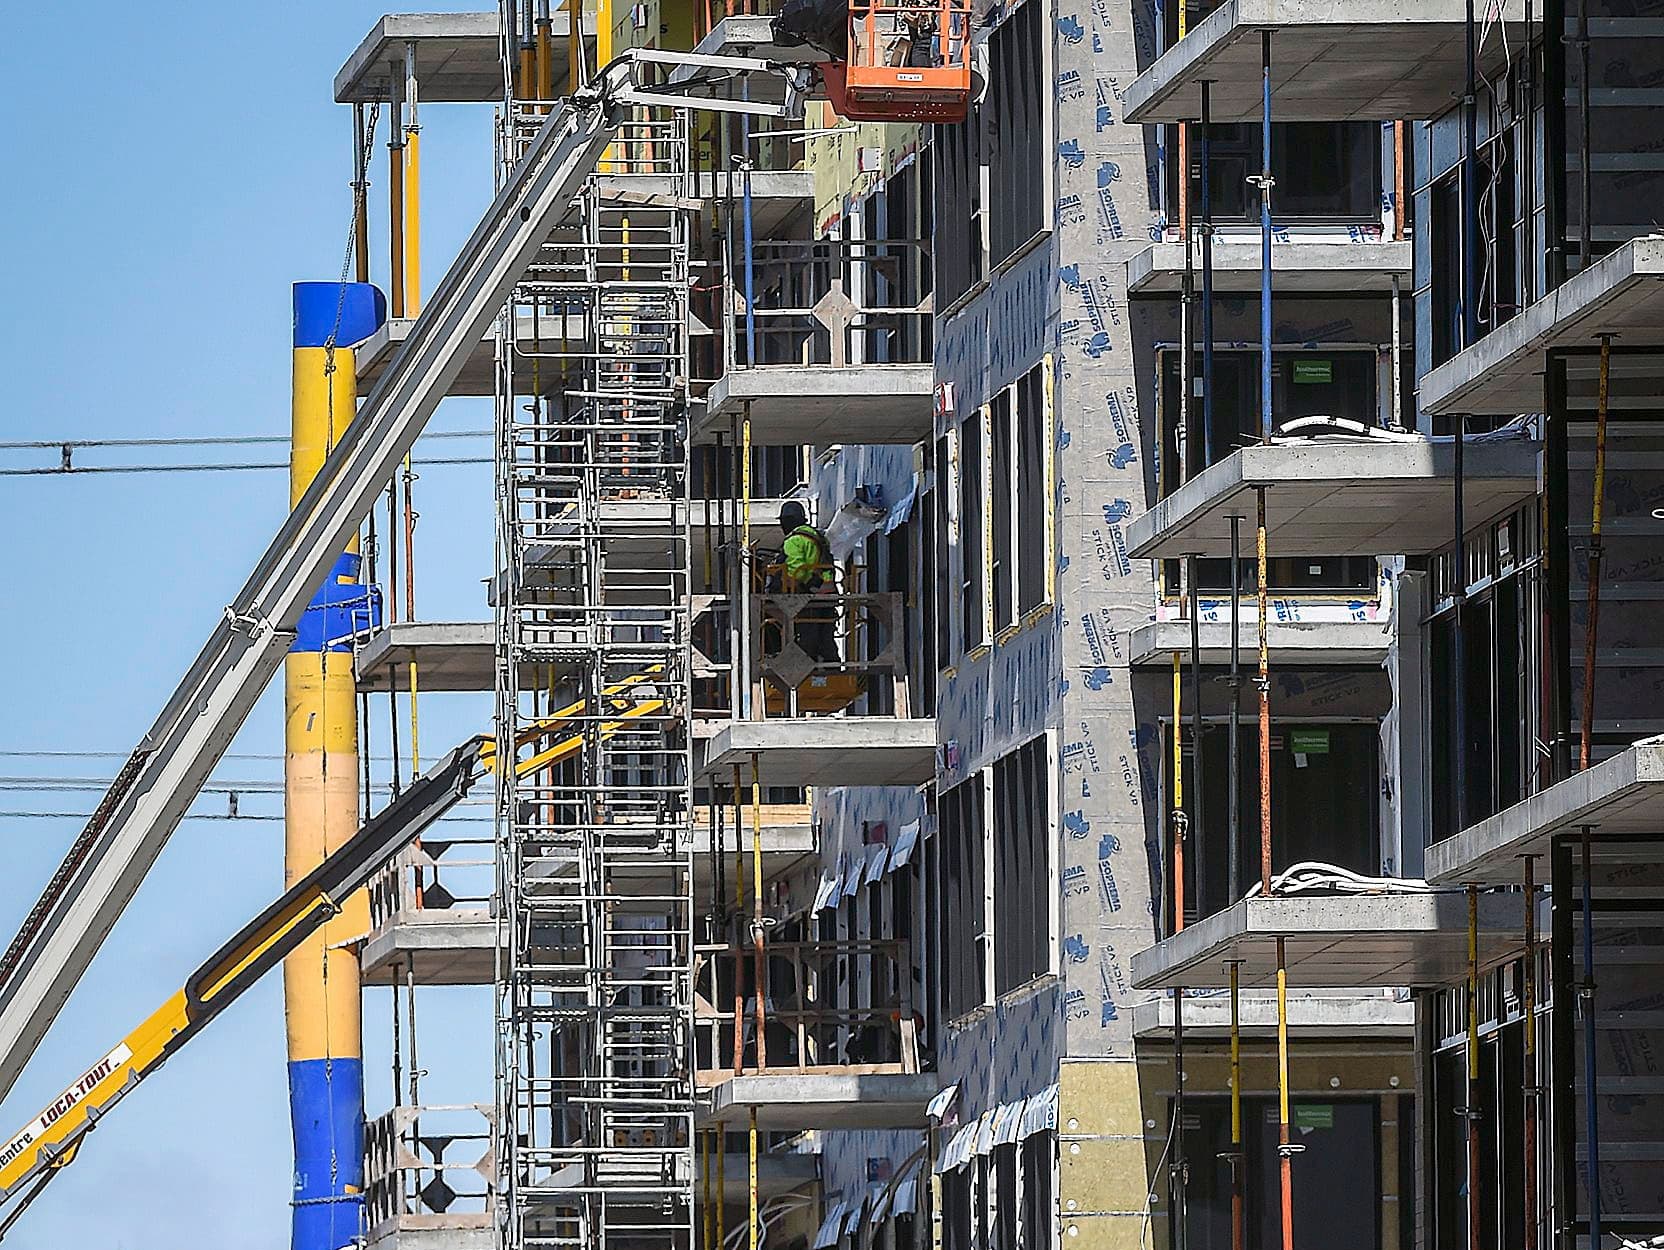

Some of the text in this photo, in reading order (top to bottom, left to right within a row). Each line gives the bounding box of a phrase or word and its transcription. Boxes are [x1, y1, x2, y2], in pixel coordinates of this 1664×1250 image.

[1101, 188, 1124, 239] SOPREMA
[1080, 282, 1101, 332] SOPREMA
[1100, 275, 1121, 326] STICK VP
[1105, 391, 1127, 443] SOPREMA
[1126, 386, 1135, 403] VP
[1092, 529, 1111, 581] STICK VP
[1112, 524, 1132, 576] SOPREMA
[1081, 613, 1103, 665] SOPREMA
[1101, 608, 1122, 659] STICK VP
[1085, 740, 1100, 773] STICK
[1119, 755, 1133, 787] STICK
[1129, 790, 1138, 806] VP
[1102, 860, 1122, 912] SOPREMA
[1106, 945, 1127, 995] STICK VP
[0, 1058, 112, 1168] entre LOCA-TOUT
